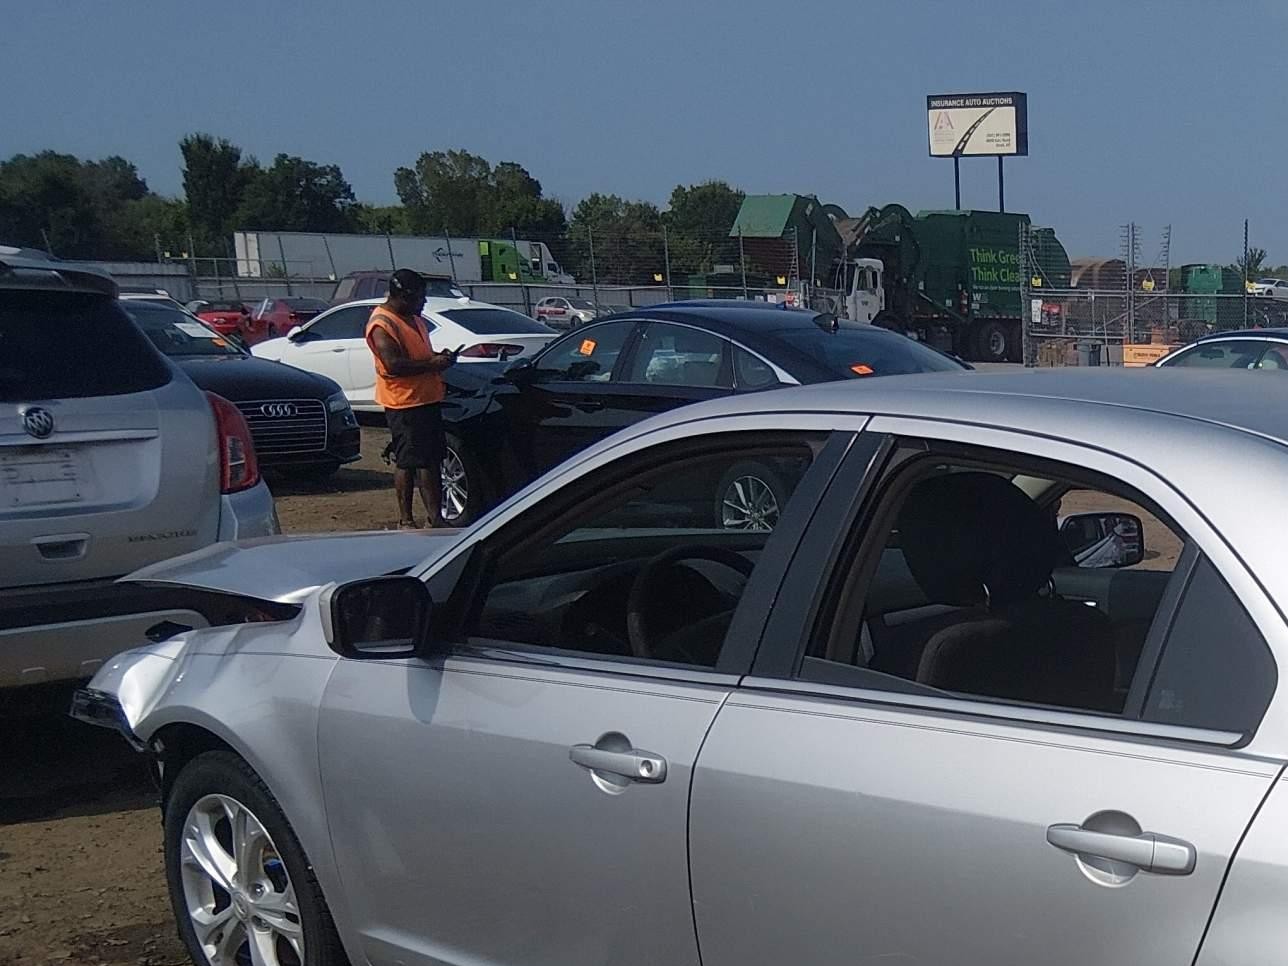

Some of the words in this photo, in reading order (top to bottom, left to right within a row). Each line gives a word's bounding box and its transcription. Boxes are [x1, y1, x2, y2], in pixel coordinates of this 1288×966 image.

[931, 99, 965, 107] INSURANCE
[982, 97, 1013, 106] AUCTIONS
[969, 247, 998, 263] Think
[971, 267, 999, 282] Think
